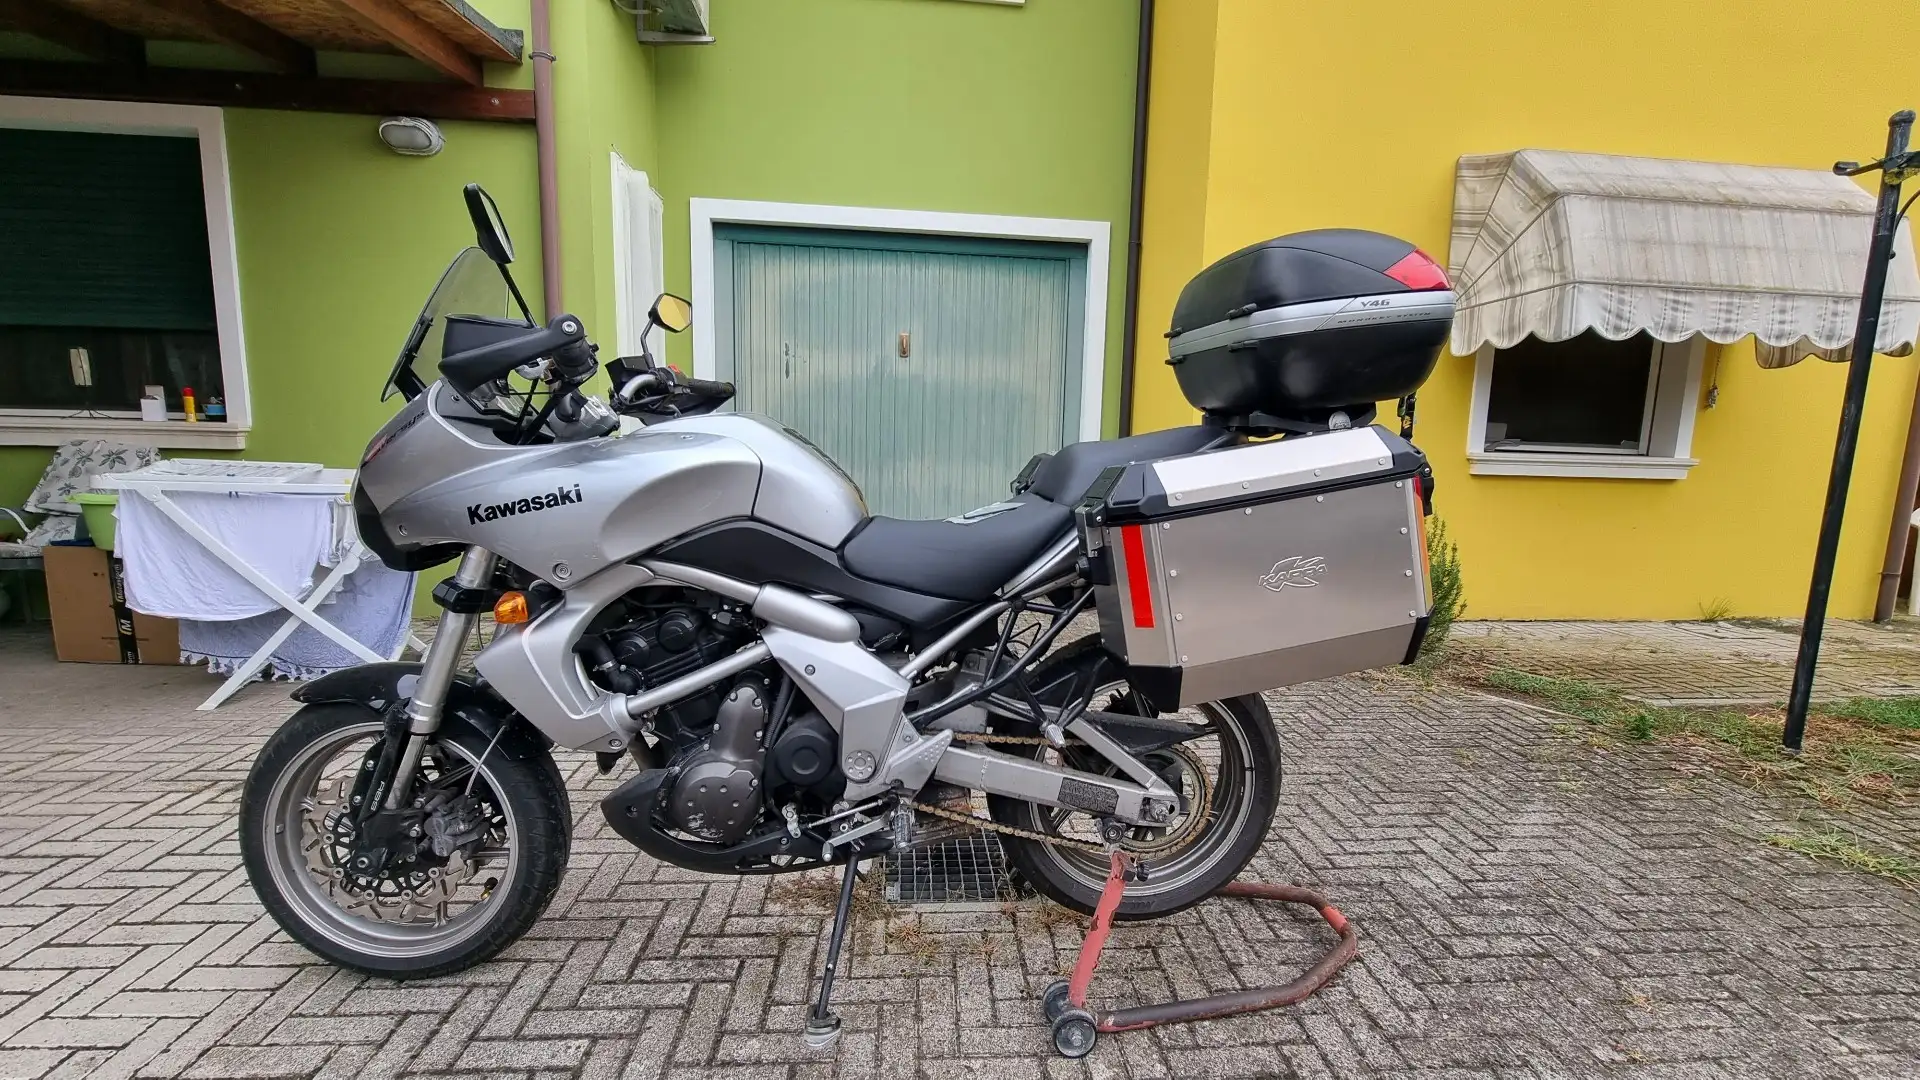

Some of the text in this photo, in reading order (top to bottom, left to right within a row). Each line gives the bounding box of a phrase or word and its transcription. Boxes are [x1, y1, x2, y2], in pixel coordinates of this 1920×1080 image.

[1360, 298, 1391, 308] V46
[466, 483, 583, 525] Kawasaki
[371, 781, 385, 811] ABS
